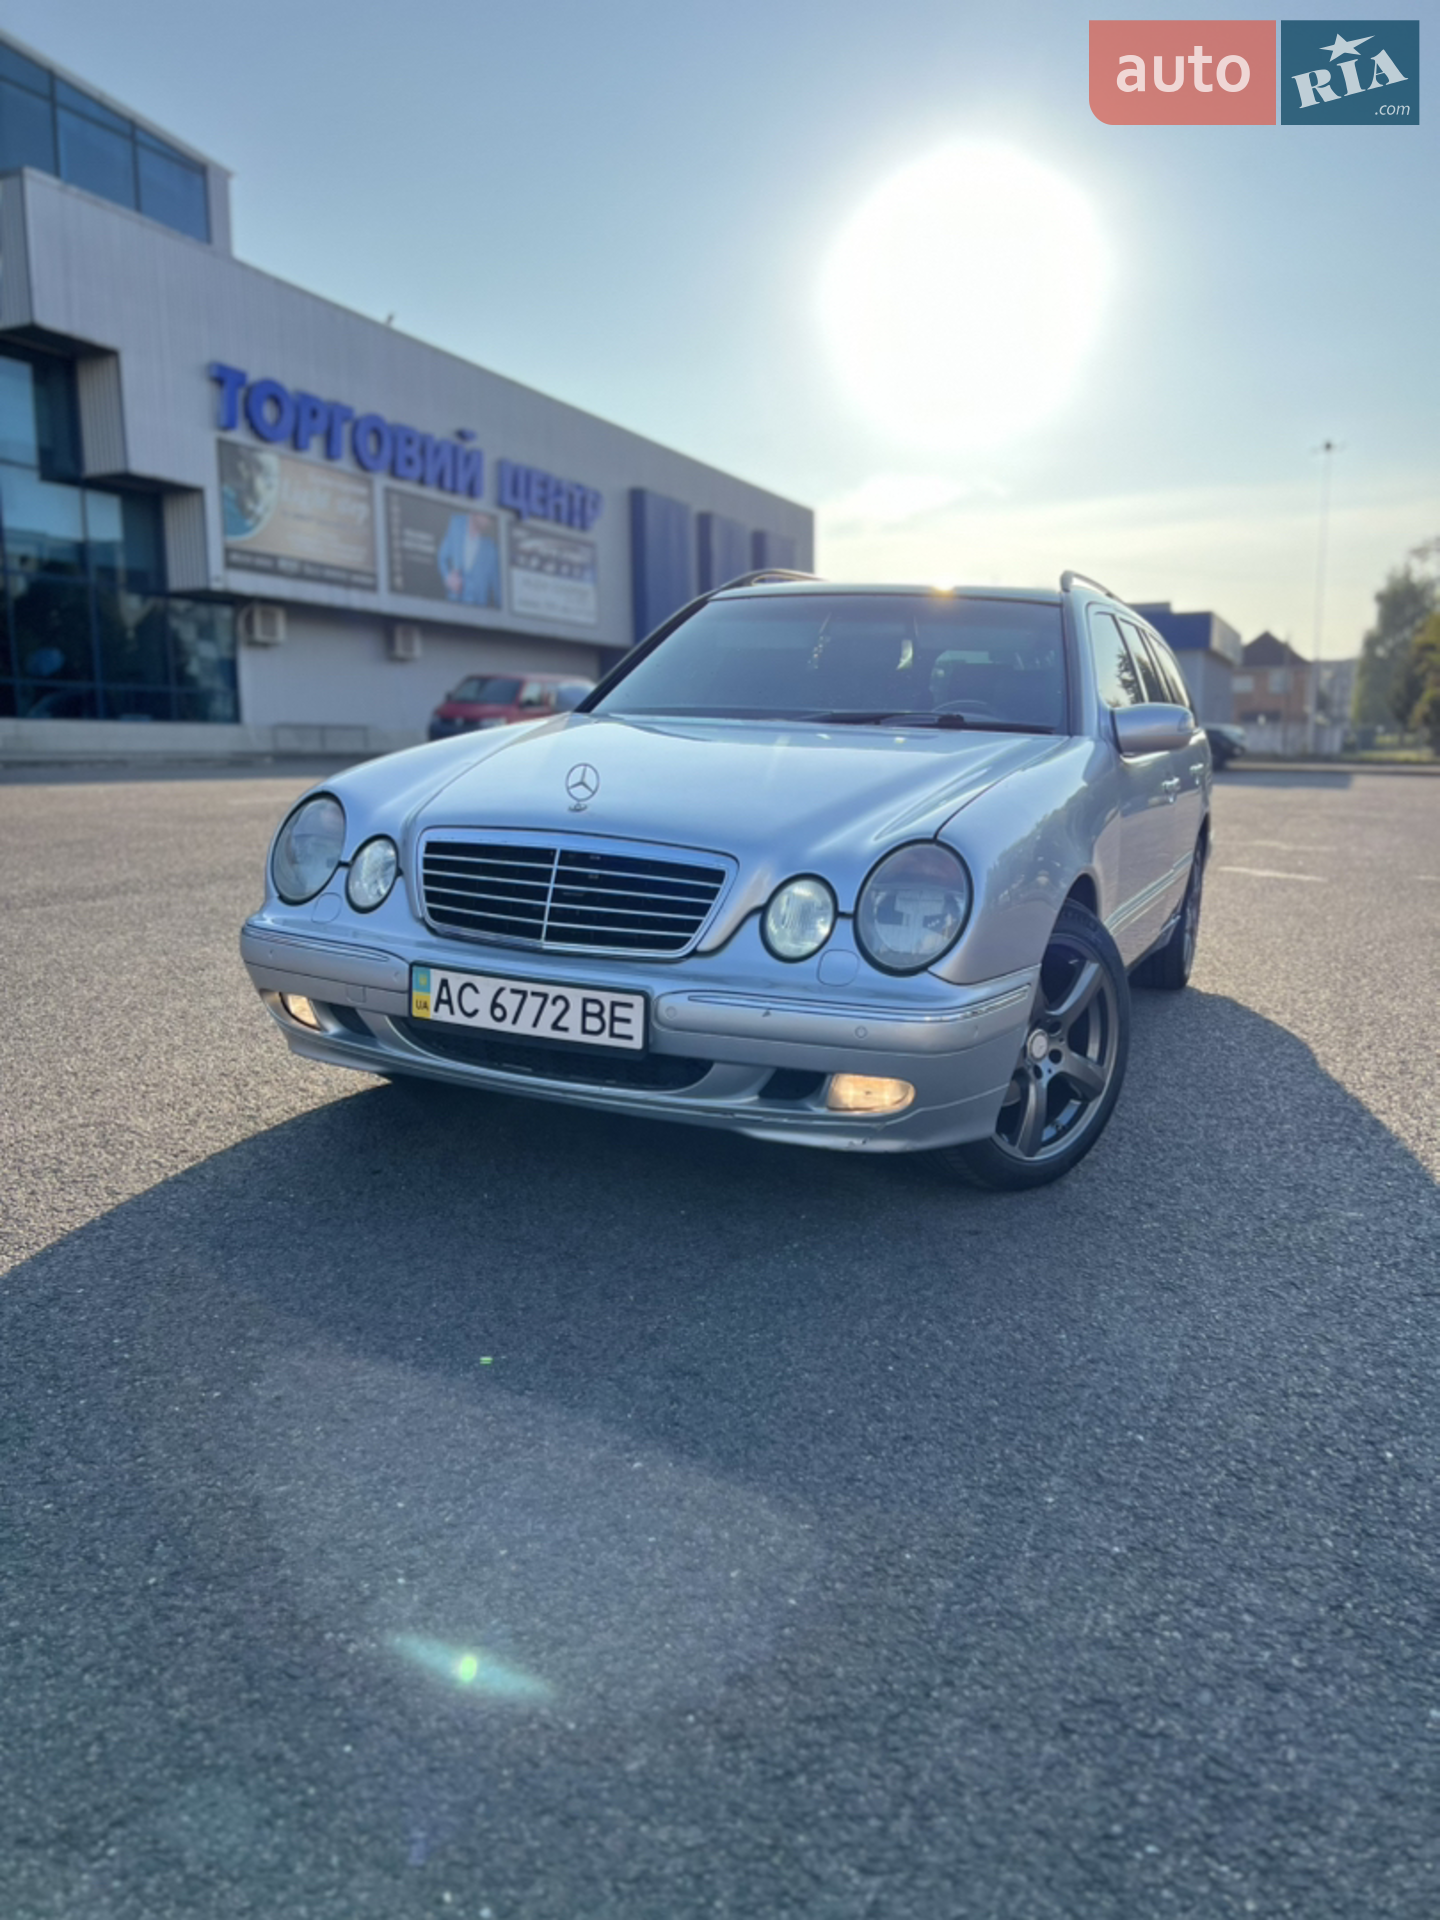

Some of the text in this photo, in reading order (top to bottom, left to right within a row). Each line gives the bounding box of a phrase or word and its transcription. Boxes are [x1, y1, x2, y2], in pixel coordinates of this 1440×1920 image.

[209, 362, 483, 498] ТОРГОВИЙ
[495, 458, 603, 531] ЦЕНТР
[415, 1000, 429, 1011] UA
[433, 978, 634, 1041] AC 6772 BE
